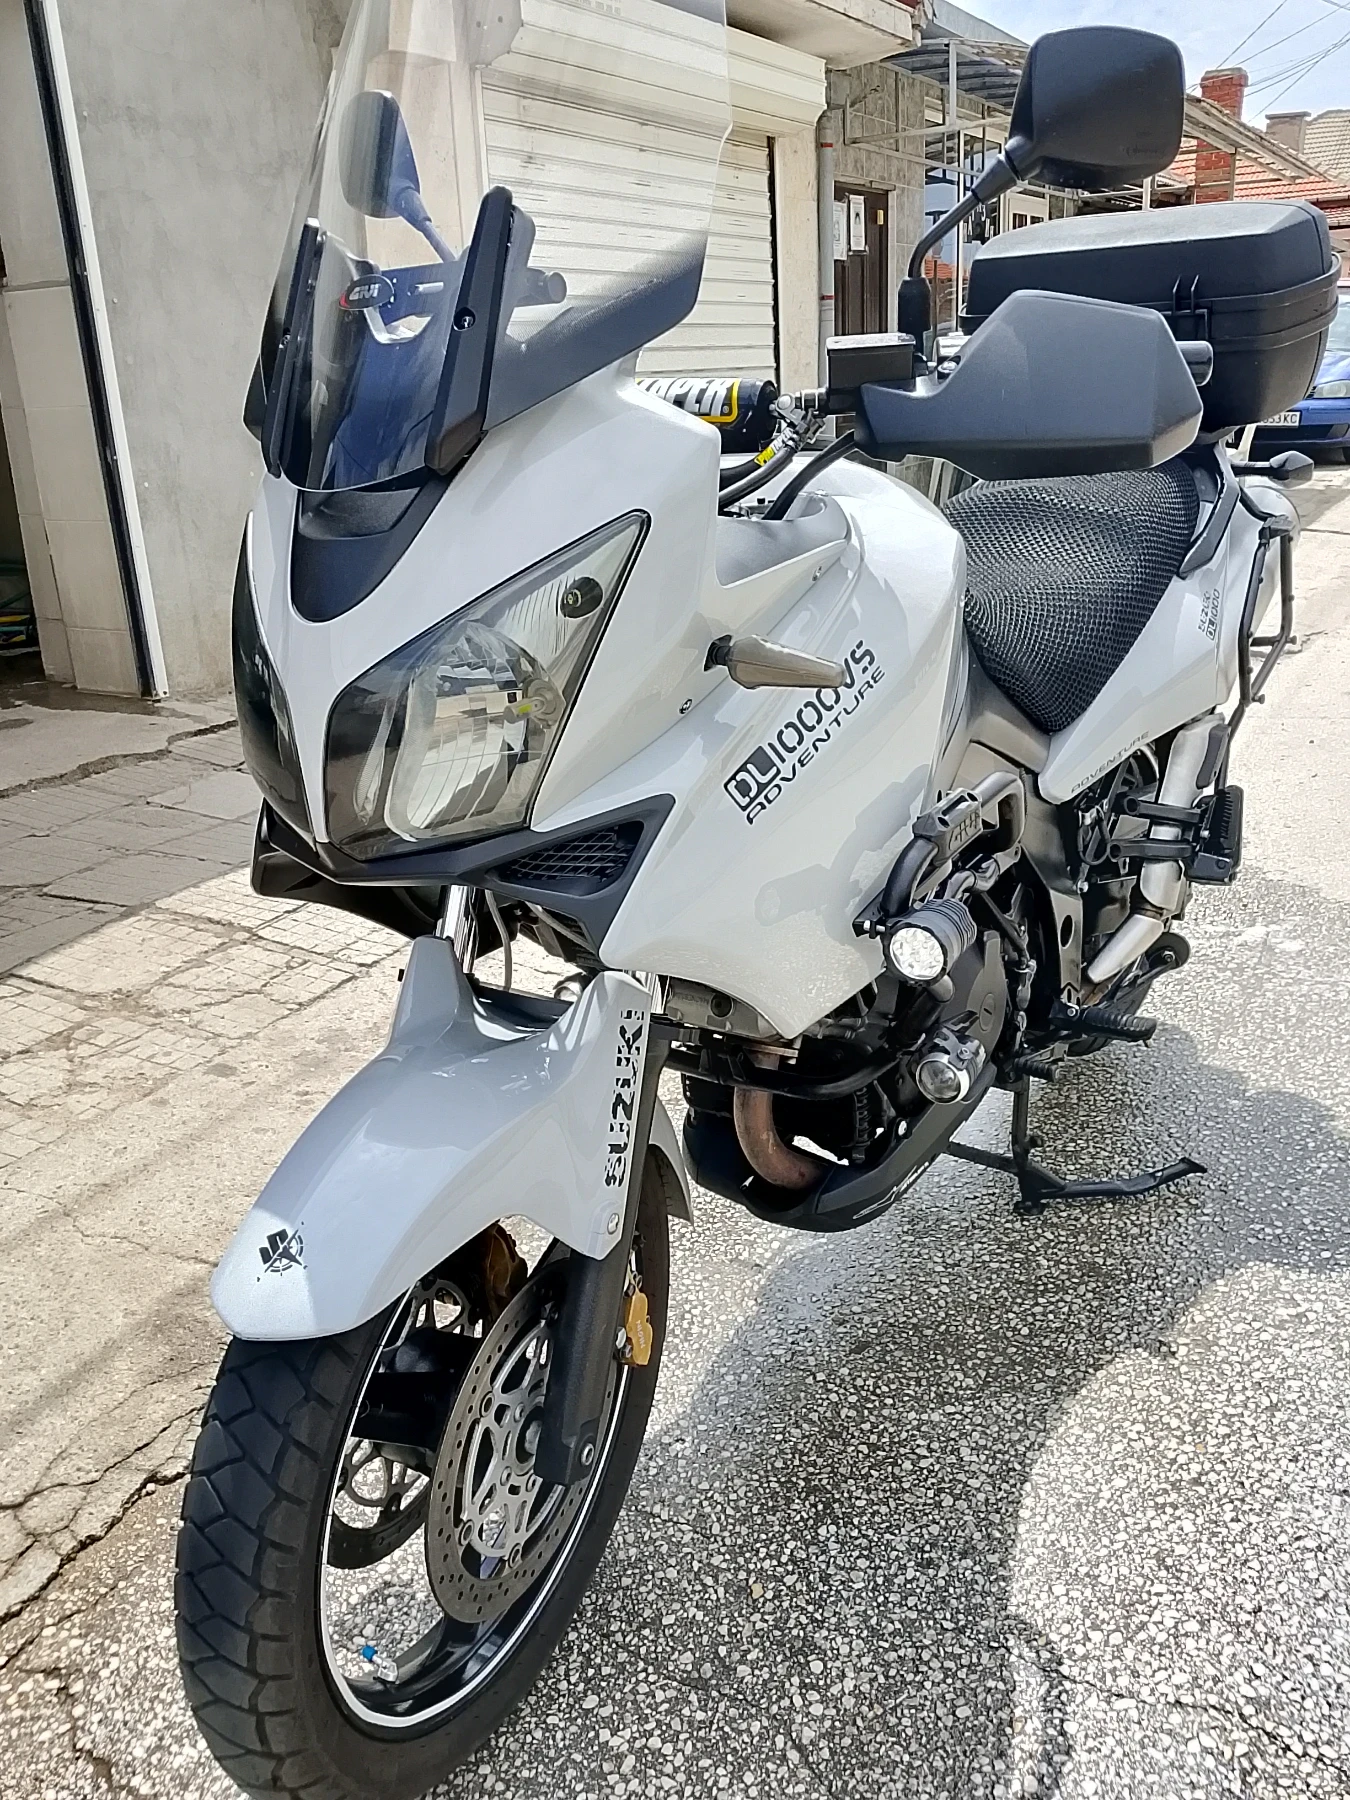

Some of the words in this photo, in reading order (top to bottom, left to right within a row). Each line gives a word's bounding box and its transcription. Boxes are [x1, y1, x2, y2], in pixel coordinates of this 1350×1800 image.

[746, 665, 886, 826] ADVENTURE
[1071, 730, 1149, 794] ADVENTURE
[604, 1009, 645, 1188] SUZUKI
